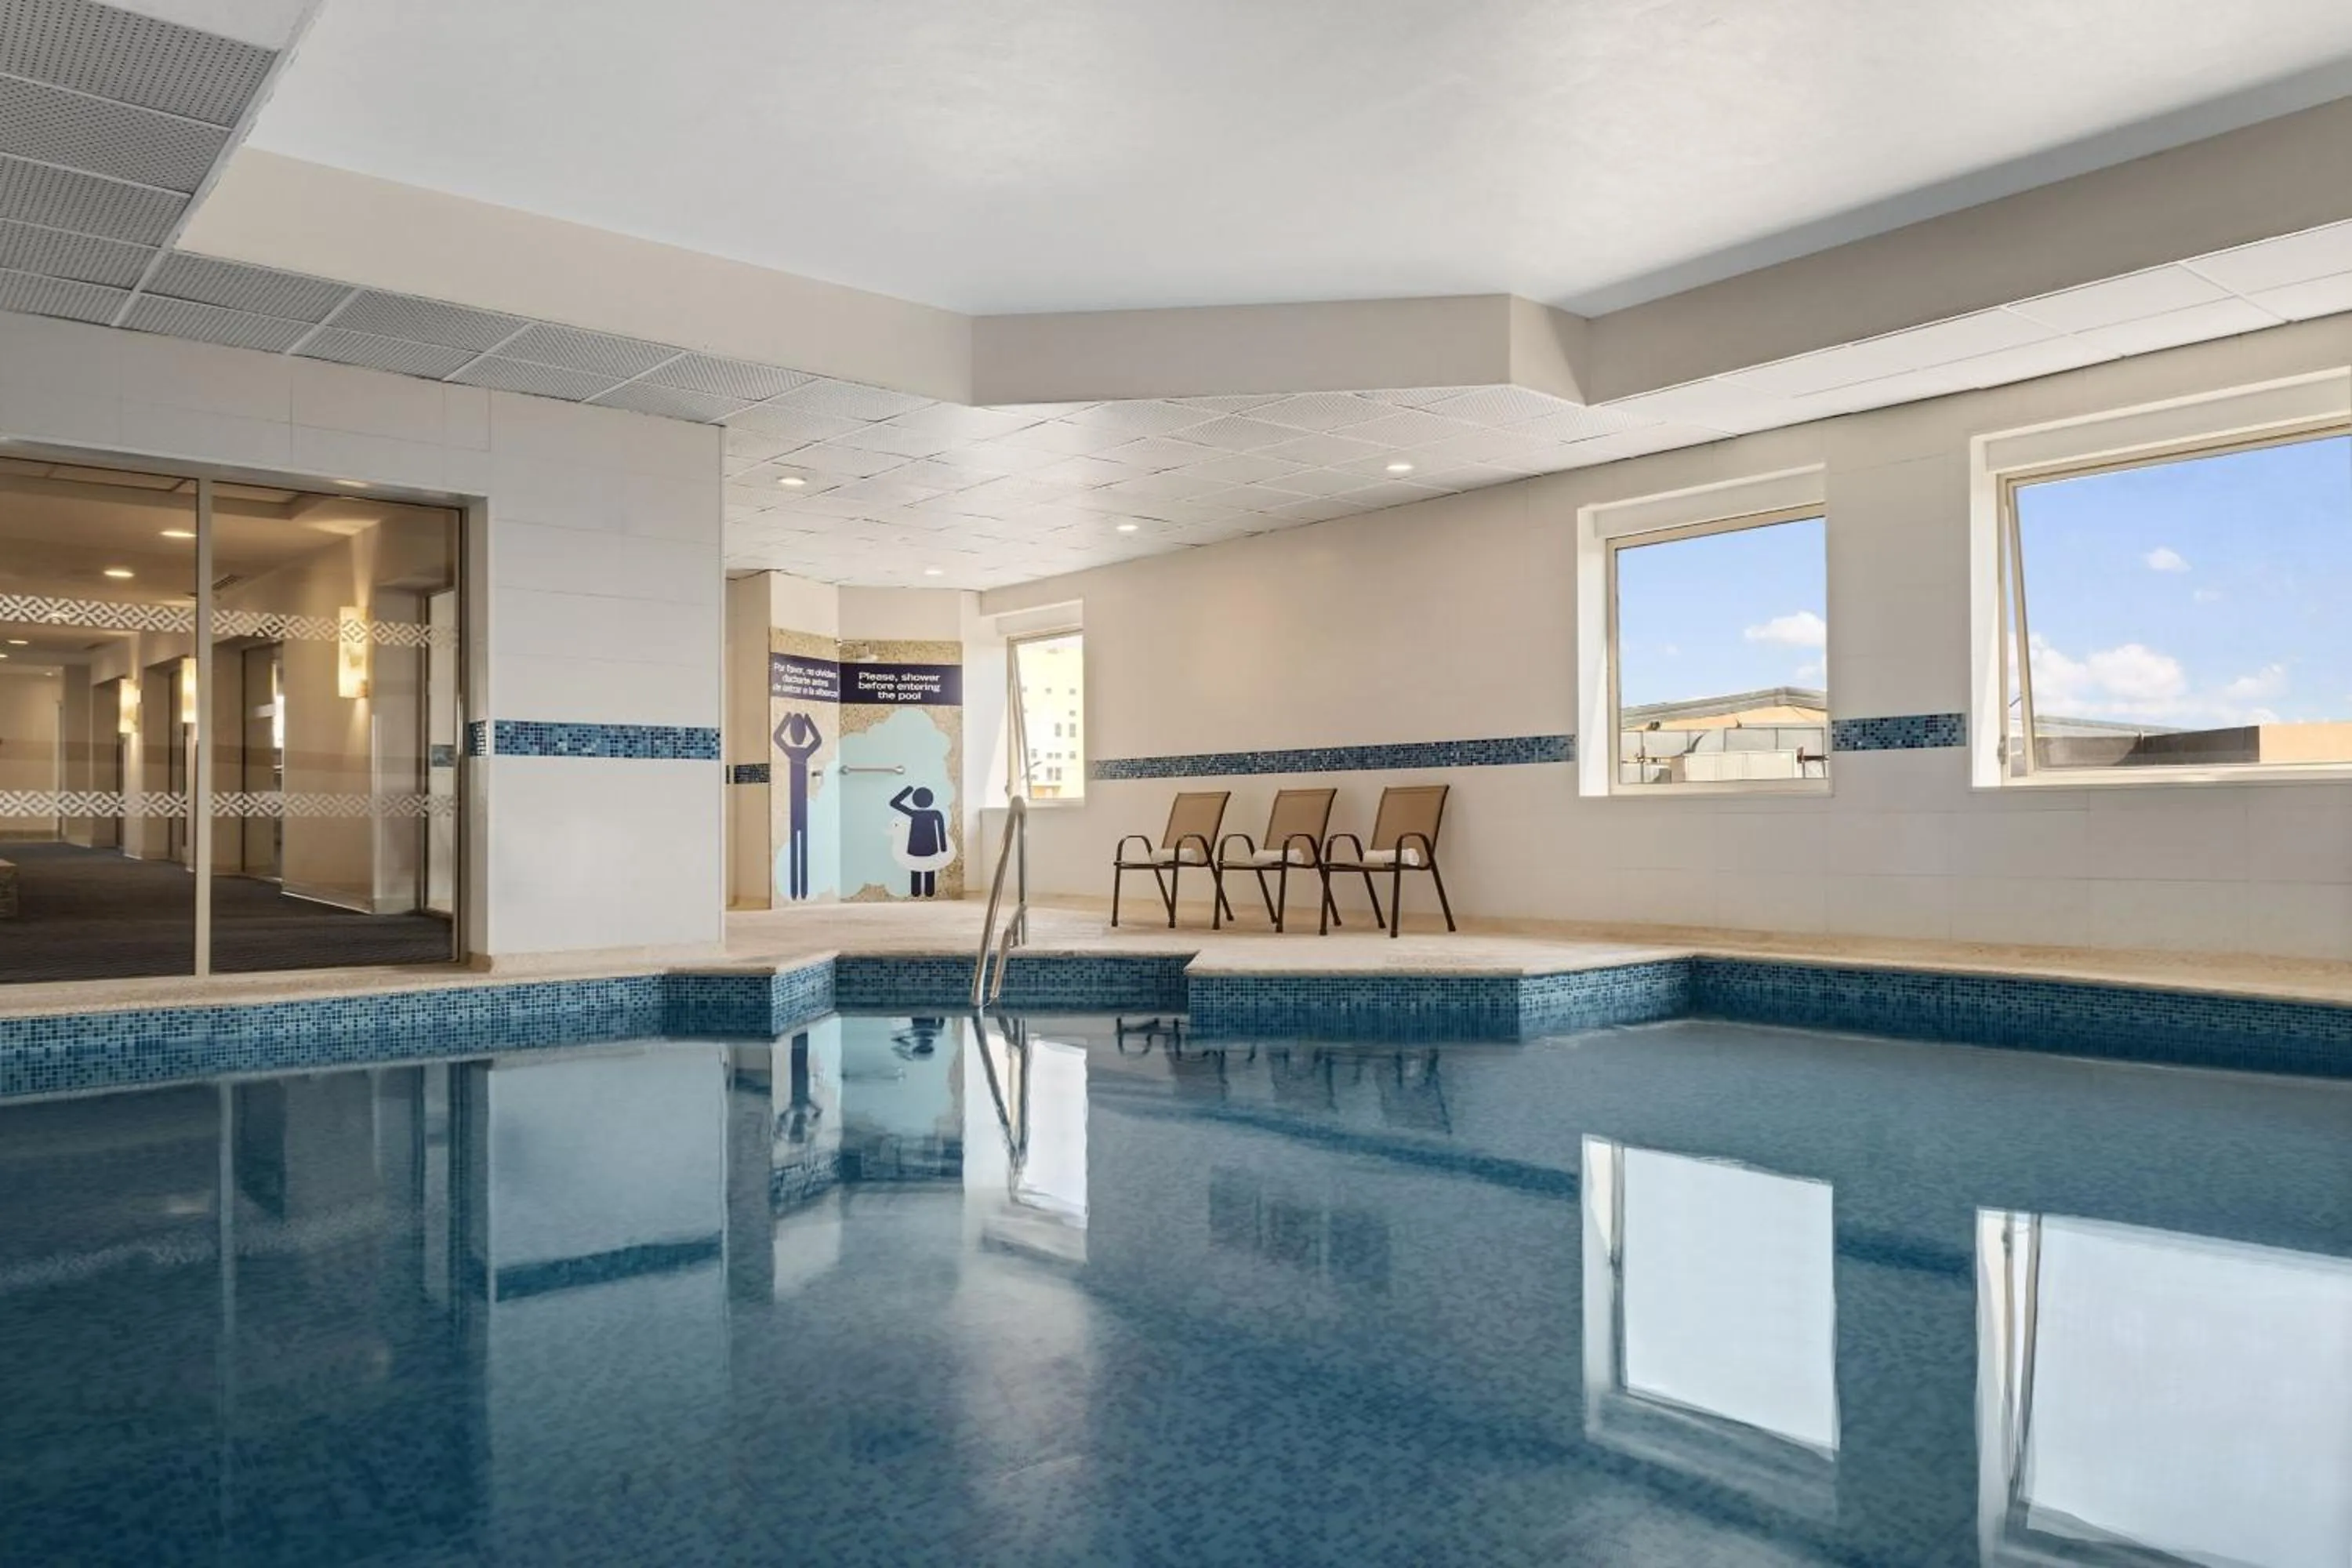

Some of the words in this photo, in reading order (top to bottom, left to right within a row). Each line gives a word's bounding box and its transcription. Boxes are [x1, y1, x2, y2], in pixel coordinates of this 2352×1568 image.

[858, 672, 898, 682] Please,
[901, 672, 941, 681] shower
[858, 681, 895, 690] before
[896, 682, 941, 692] entering
[898, 691, 921, 701] pool
